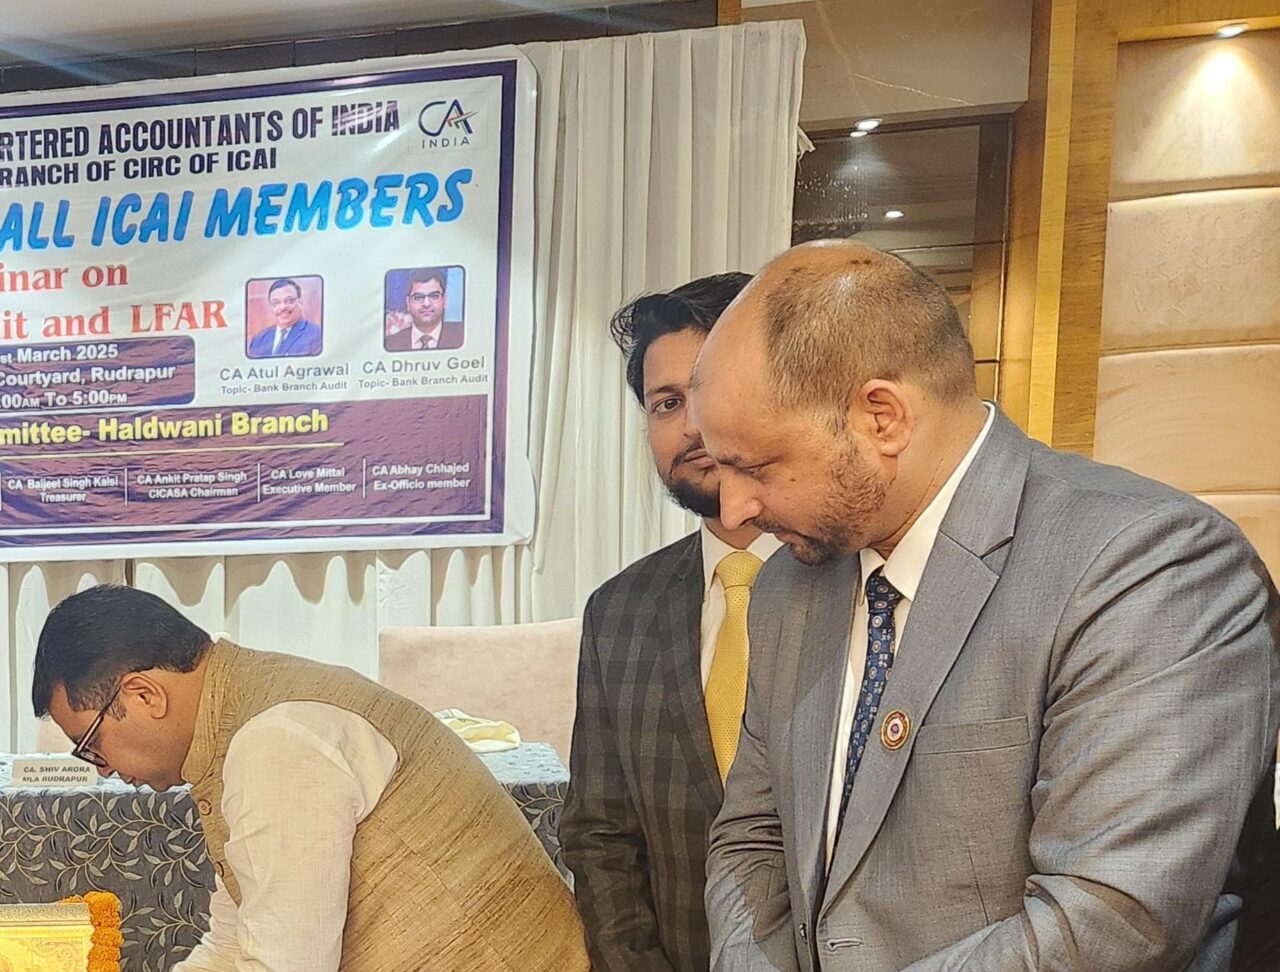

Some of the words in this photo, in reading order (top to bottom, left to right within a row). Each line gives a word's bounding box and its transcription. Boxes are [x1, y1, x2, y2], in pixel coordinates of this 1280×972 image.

[98, 110, 282, 154] ACCOUNTANTS
[292, 106, 323, 139] OF
[331, 100, 400, 137] INDIA
[421, 137, 470, 149] INDIA
[86, 160, 116, 182] OF
[123, 154, 181, 179] CIRC
[189, 151, 220, 173] OF
[227, 147, 277, 171] ICAI
[91, 190, 195, 247] ICAI
[203, 168, 473, 239] MEMBERS
[82, 263, 129, 288] on
[42, 307, 111, 338] and
[129, 299, 229, 334] LFAR
[17, 346, 70, 363] March
[76, 343, 119, 360] 2025
[220, 368, 243, 381] CA
[247, 365, 279, 379] Atul
[283, 362, 349, 380] Agrawal
[362, 361, 387, 374] CA
[392, 360, 440, 373] Dhruv
[447, 356, 485, 370] Goel
[91, 365, 176, 383] Rudrapur
[358, 379, 389, 390] Topic-
[392, 377, 418, 387] Bank
[421, 376, 458, 385] Branch
[460, 374, 488, 384] Audit
[221, 385, 251, 395] Topic-
[254, 383, 279, 393] Bank
[282, 382, 318, 391] Branch
[319, 381, 347, 390] Audit
[44, 391, 68, 407] To
[72, 389, 128, 405] 5:00PM
[98, 413, 222, 441] Haldwani
[231, 408, 329, 436] Branch
[271, 469, 287, 480] CA
[288, 469, 314, 479] Love
[316, 467, 345, 478] Mittal
[372, 465, 389, 476] CA
[389, 464, 423, 476] Abhay
[425, 462, 469, 475] Chhajed
[7, 479, 23, 490] CA
[62, 476, 91, 490] Singh
[137, 474, 154, 485] CA
[155, 473, 182, 484] Ankit
[183, 473, 216, 485] Pratap
[218, 471, 247, 483] Singh
[373, 480, 424, 490] Ex-Officio
[427, 478, 470, 489] member
[148, 488, 189, 499] CICASA
[190, 487, 239, 497] Chairman
[262, 483, 312, 494] Executive
[313, 482, 357, 493] Member
[40, 492, 87, 503] Treasurer
[42, 775, 88, 783] RUDRAPUR
